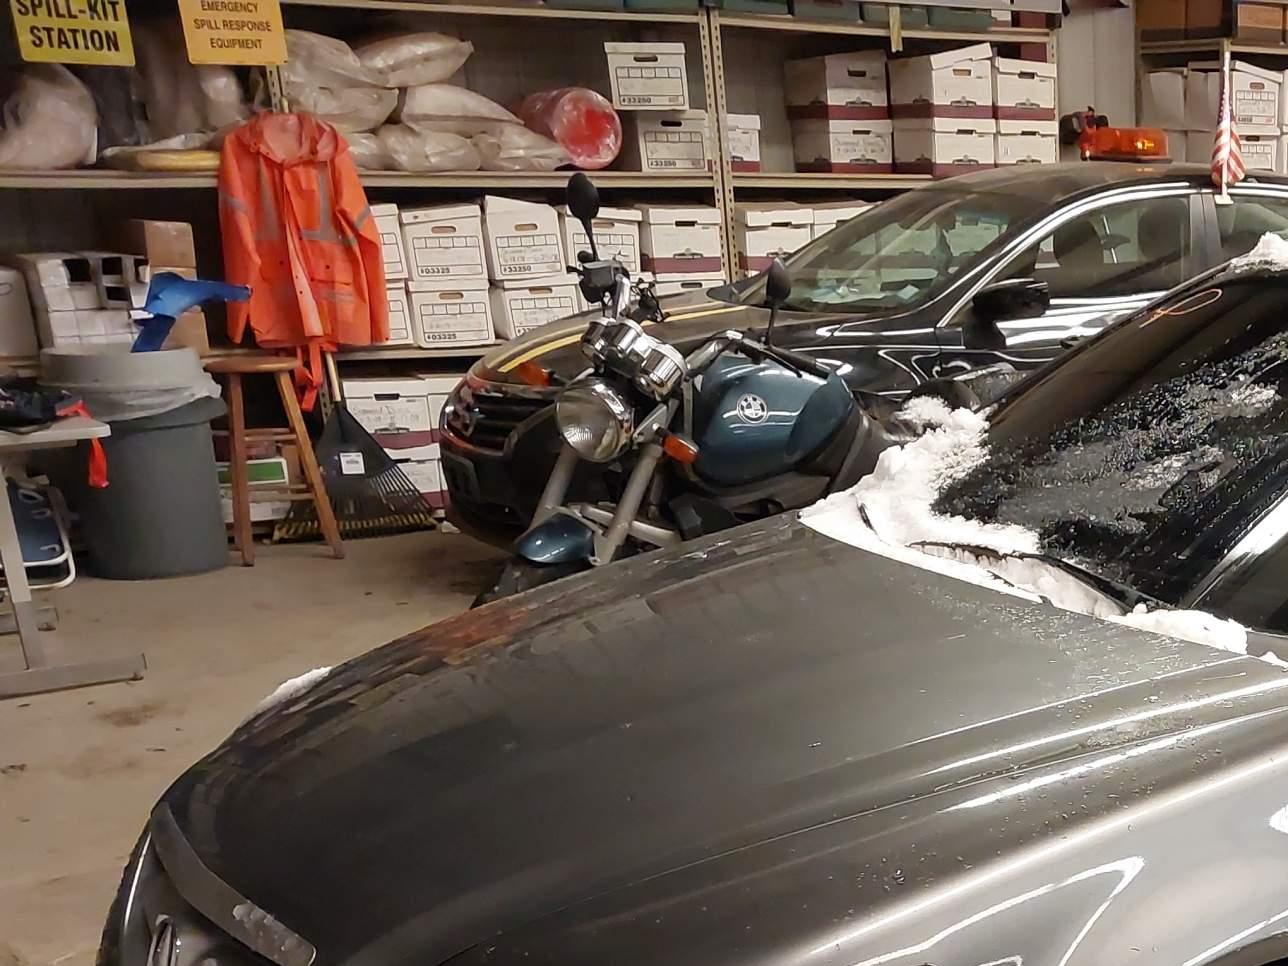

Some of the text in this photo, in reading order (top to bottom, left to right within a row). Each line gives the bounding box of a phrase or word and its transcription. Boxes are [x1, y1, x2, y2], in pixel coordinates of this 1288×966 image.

[16, 0, 120, 21] SPILL-KIT
[201, 0, 259, 13] EMERGENCY
[193, 18, 272, 32] SPILL RESPONSE
[29, 25, 120, 52] STATION
[209, 38, 263, 49] EQUIPMENT
